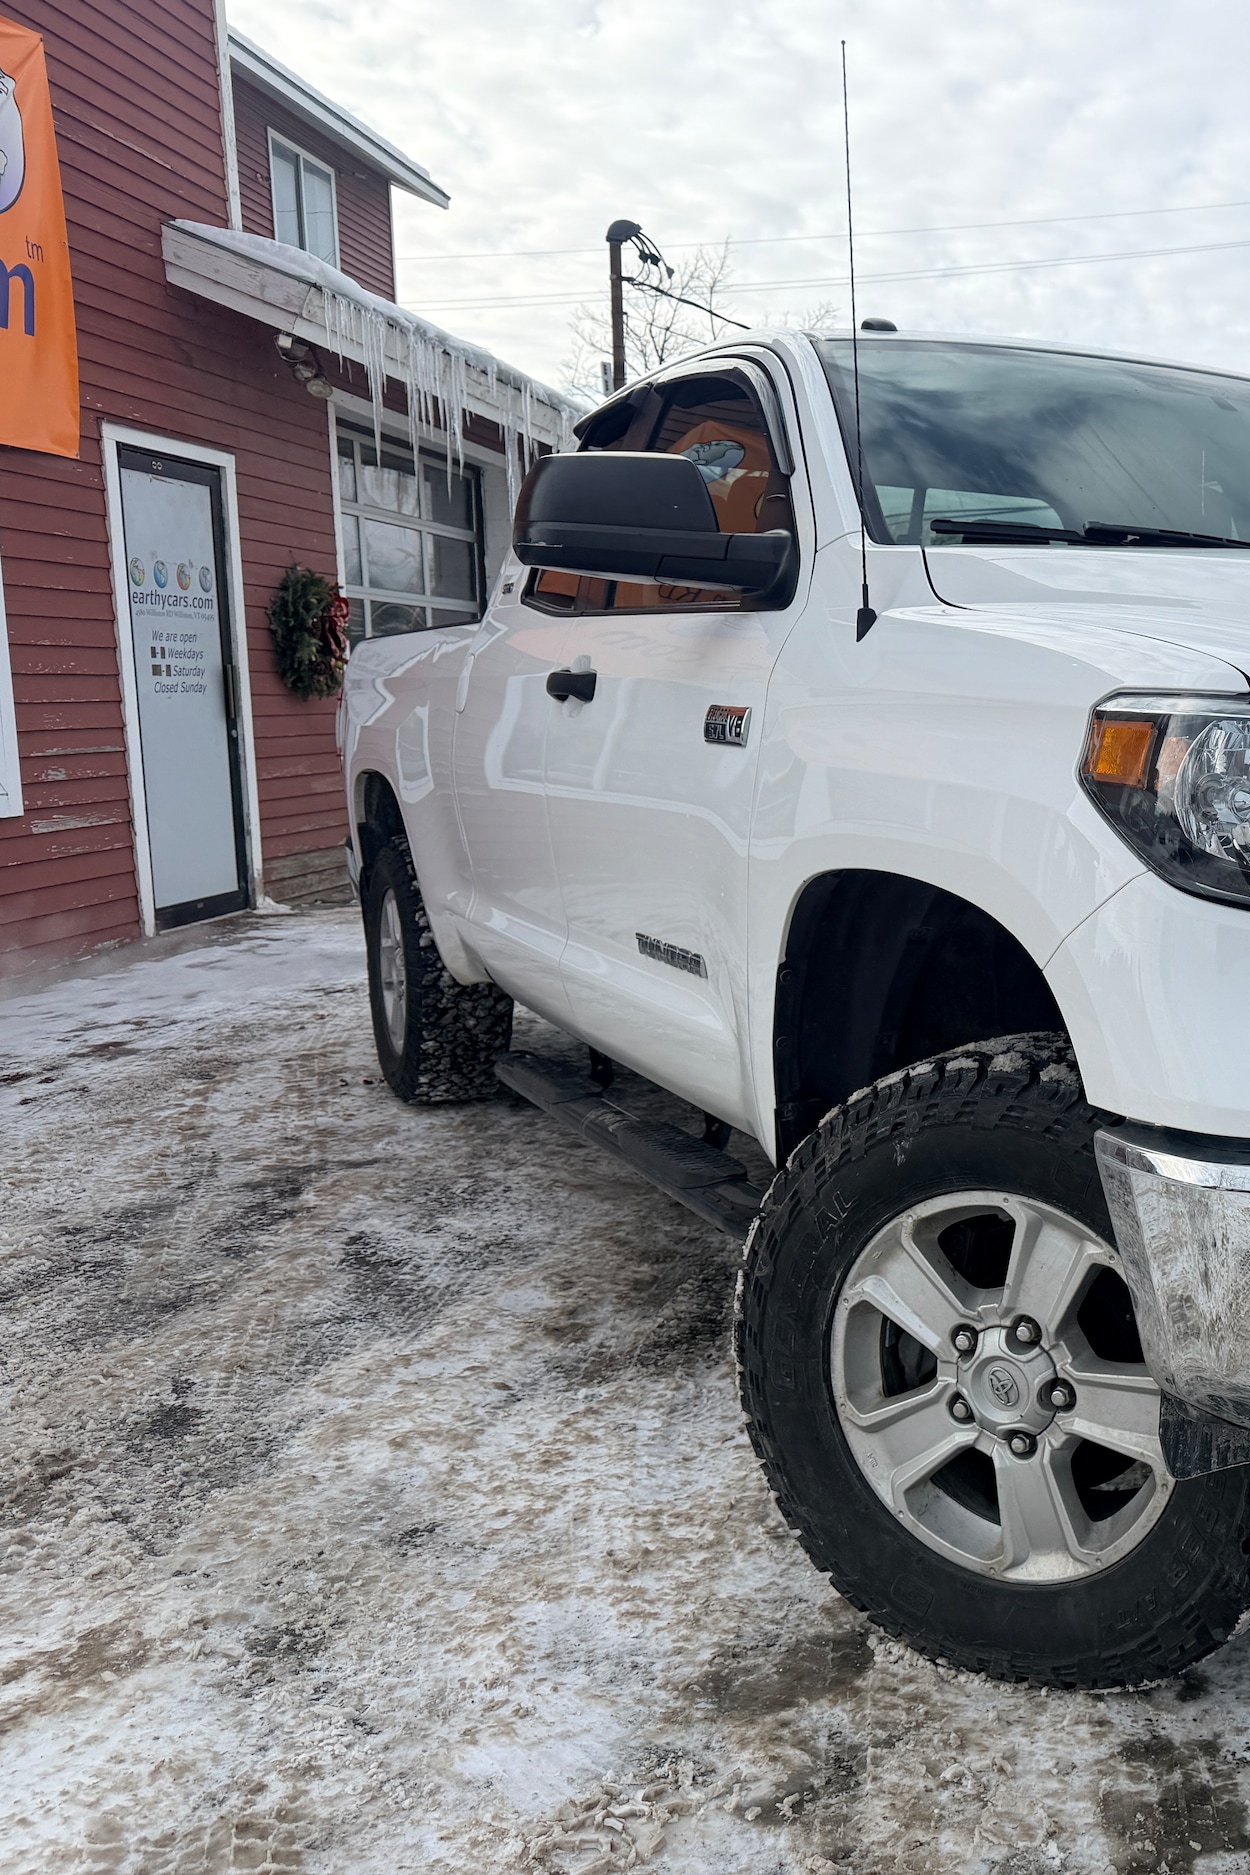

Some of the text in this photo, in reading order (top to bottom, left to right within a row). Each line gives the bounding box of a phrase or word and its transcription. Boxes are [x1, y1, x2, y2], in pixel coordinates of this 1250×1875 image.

[132, 589, 213, 610] earthycars.com
[152, 630, 197, 645] We are open
[168, 647, 203, 661] Weekdays
[173, 665, 205, 679] Saturday
[154, 681, 207, 695] Closed Sunday
